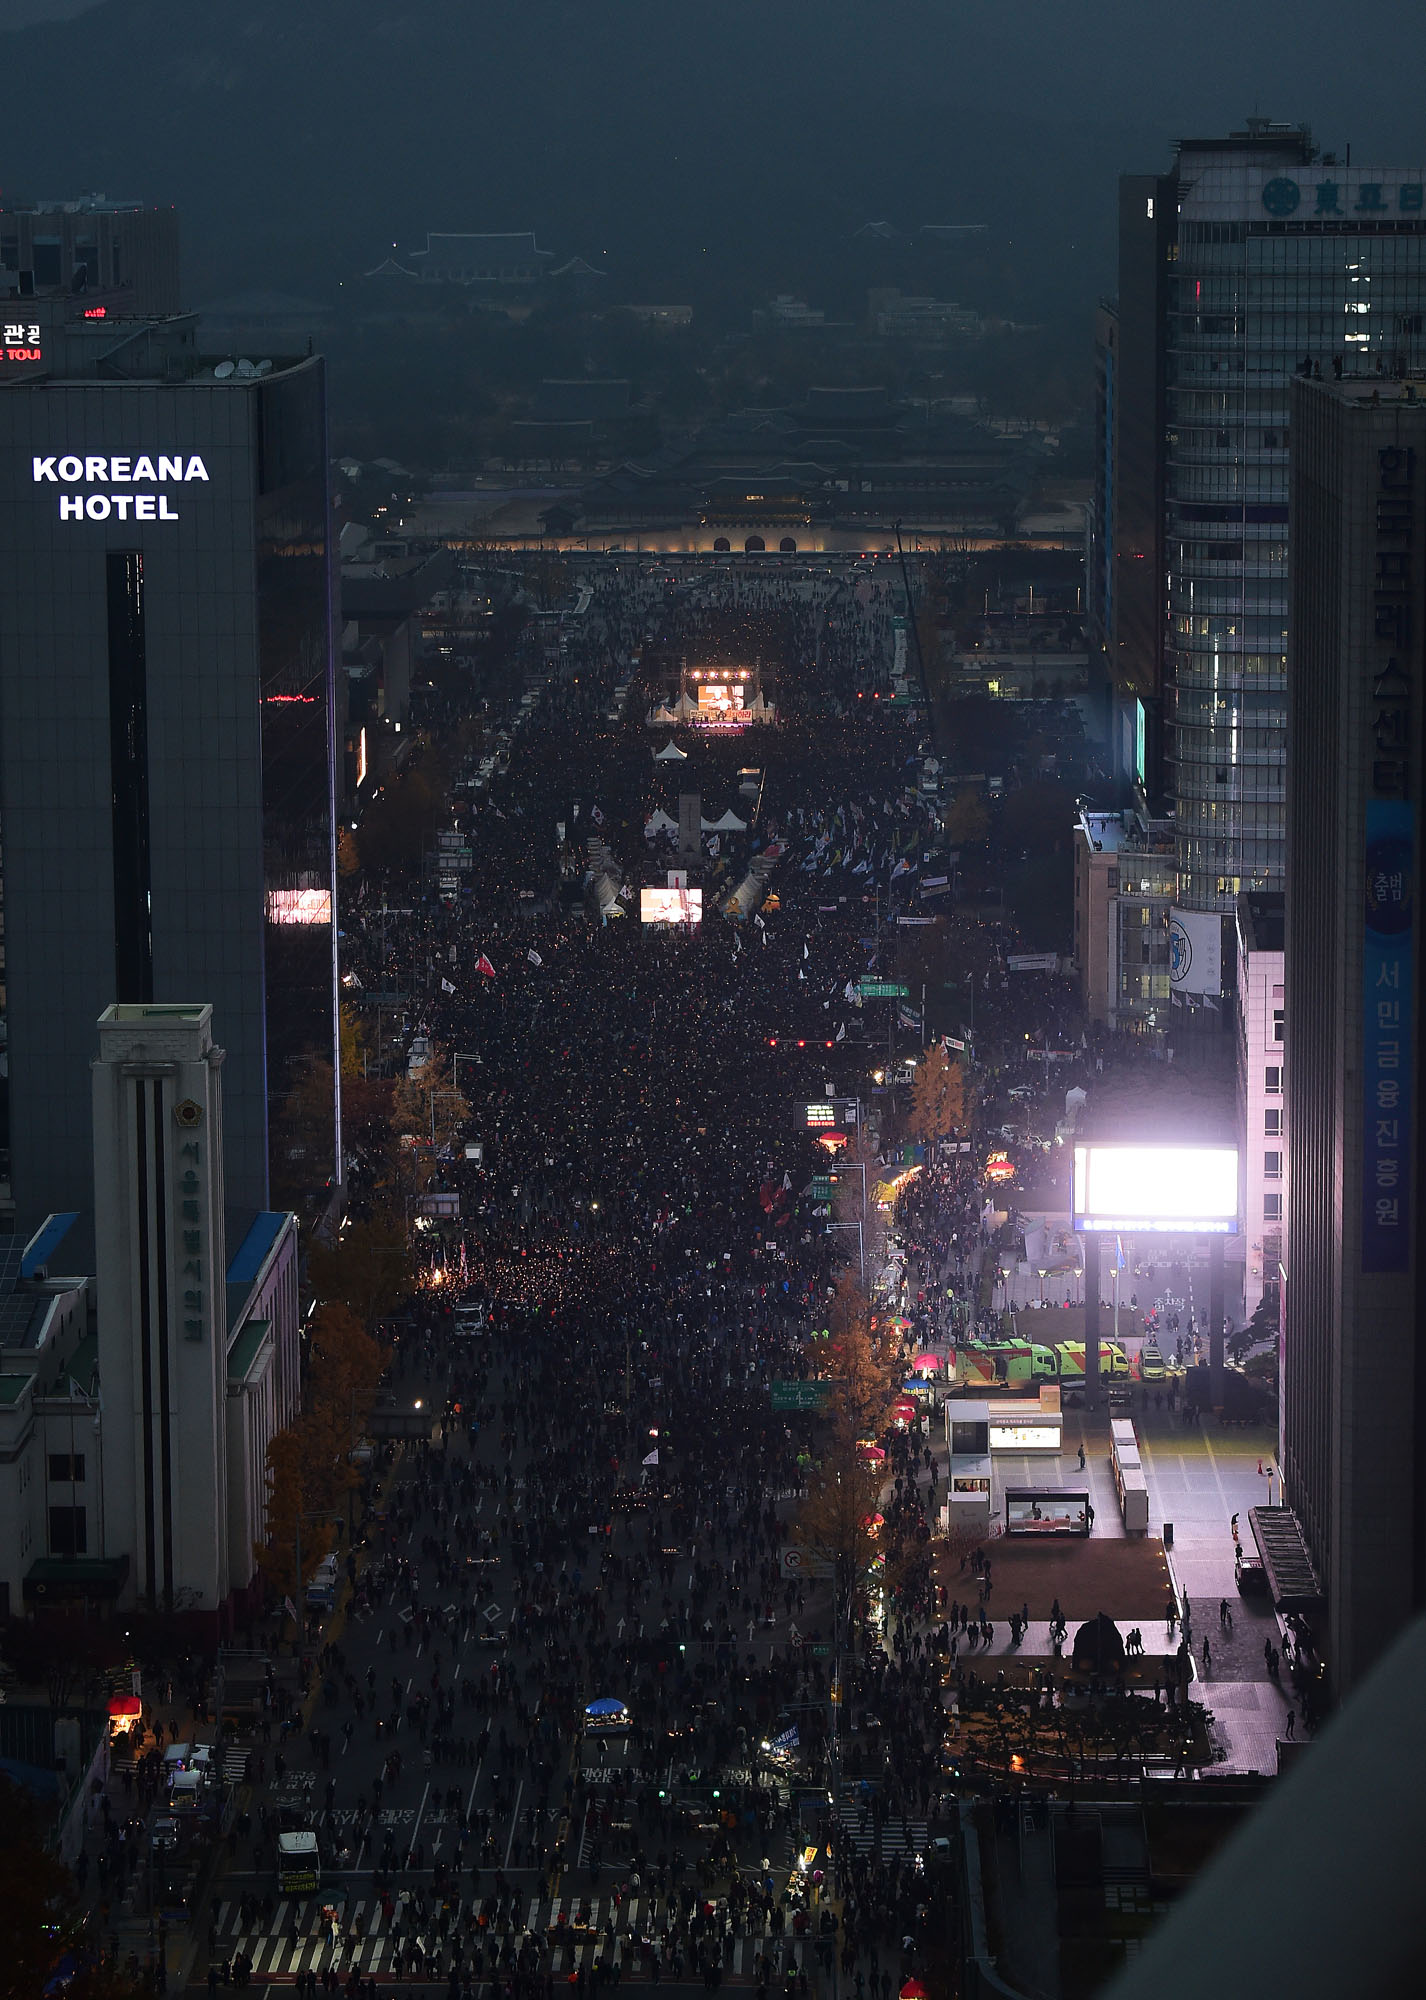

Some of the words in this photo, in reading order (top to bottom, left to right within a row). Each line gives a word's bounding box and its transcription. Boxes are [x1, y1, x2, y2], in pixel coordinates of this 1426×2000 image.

[32, 455, 210, 483] KOREANA
[59, 495, 180, 521] HOTEL
[1374, 871, 1402, 902] 출범
[1375, 960, 1400, 1227] 서민금융진흥원
[180, 1141, 202, 1342] 서울특별시의회
